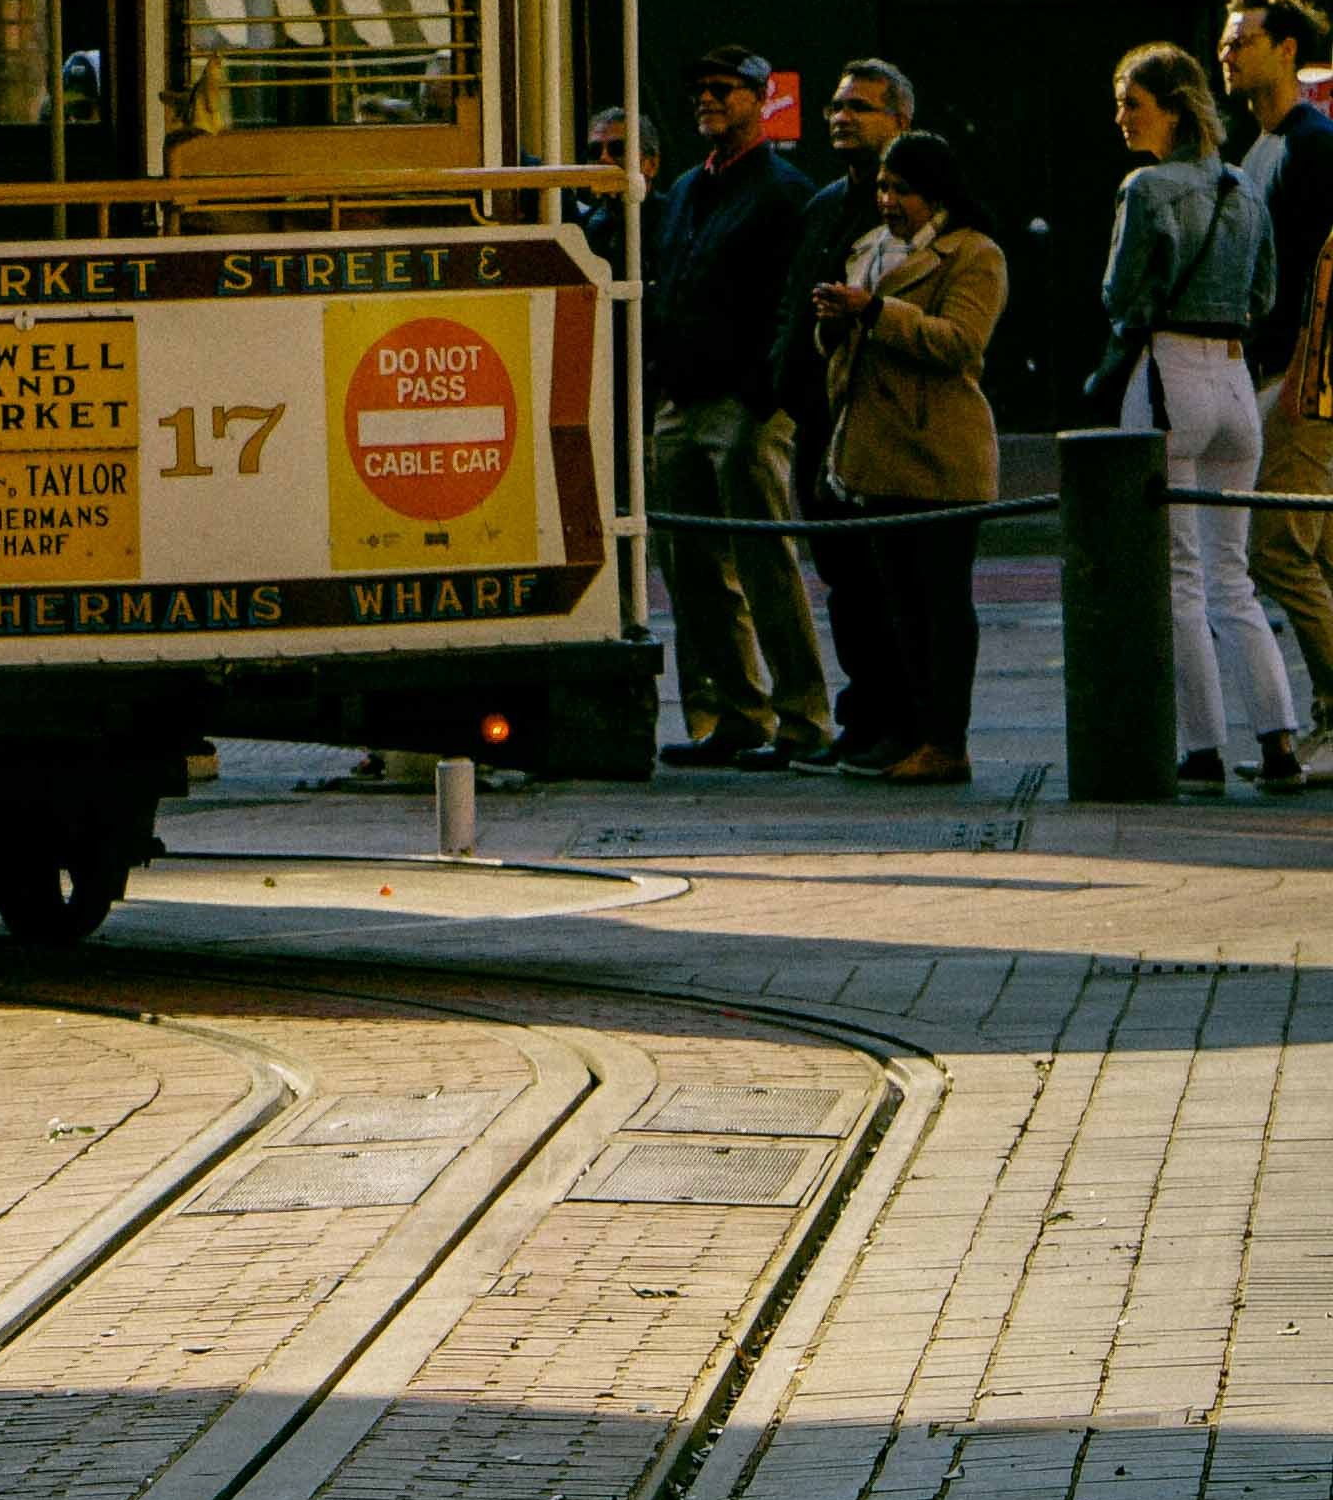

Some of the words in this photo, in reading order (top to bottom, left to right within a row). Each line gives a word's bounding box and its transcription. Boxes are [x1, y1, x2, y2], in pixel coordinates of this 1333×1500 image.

[219, 247, 448, 295] STREET
[377, 348, 418, 377] DO
[425, 343, 482, 374] NOT
[396, 375, 467, 403] PASS
[158, 402, 287, 479] 17
[365, 448, 444, 478] CABLE
[451, 445, 502, 475] CAR
[25, 463, 126, 497] TAYLOR
[351, 573, 539, 622] WHARF
